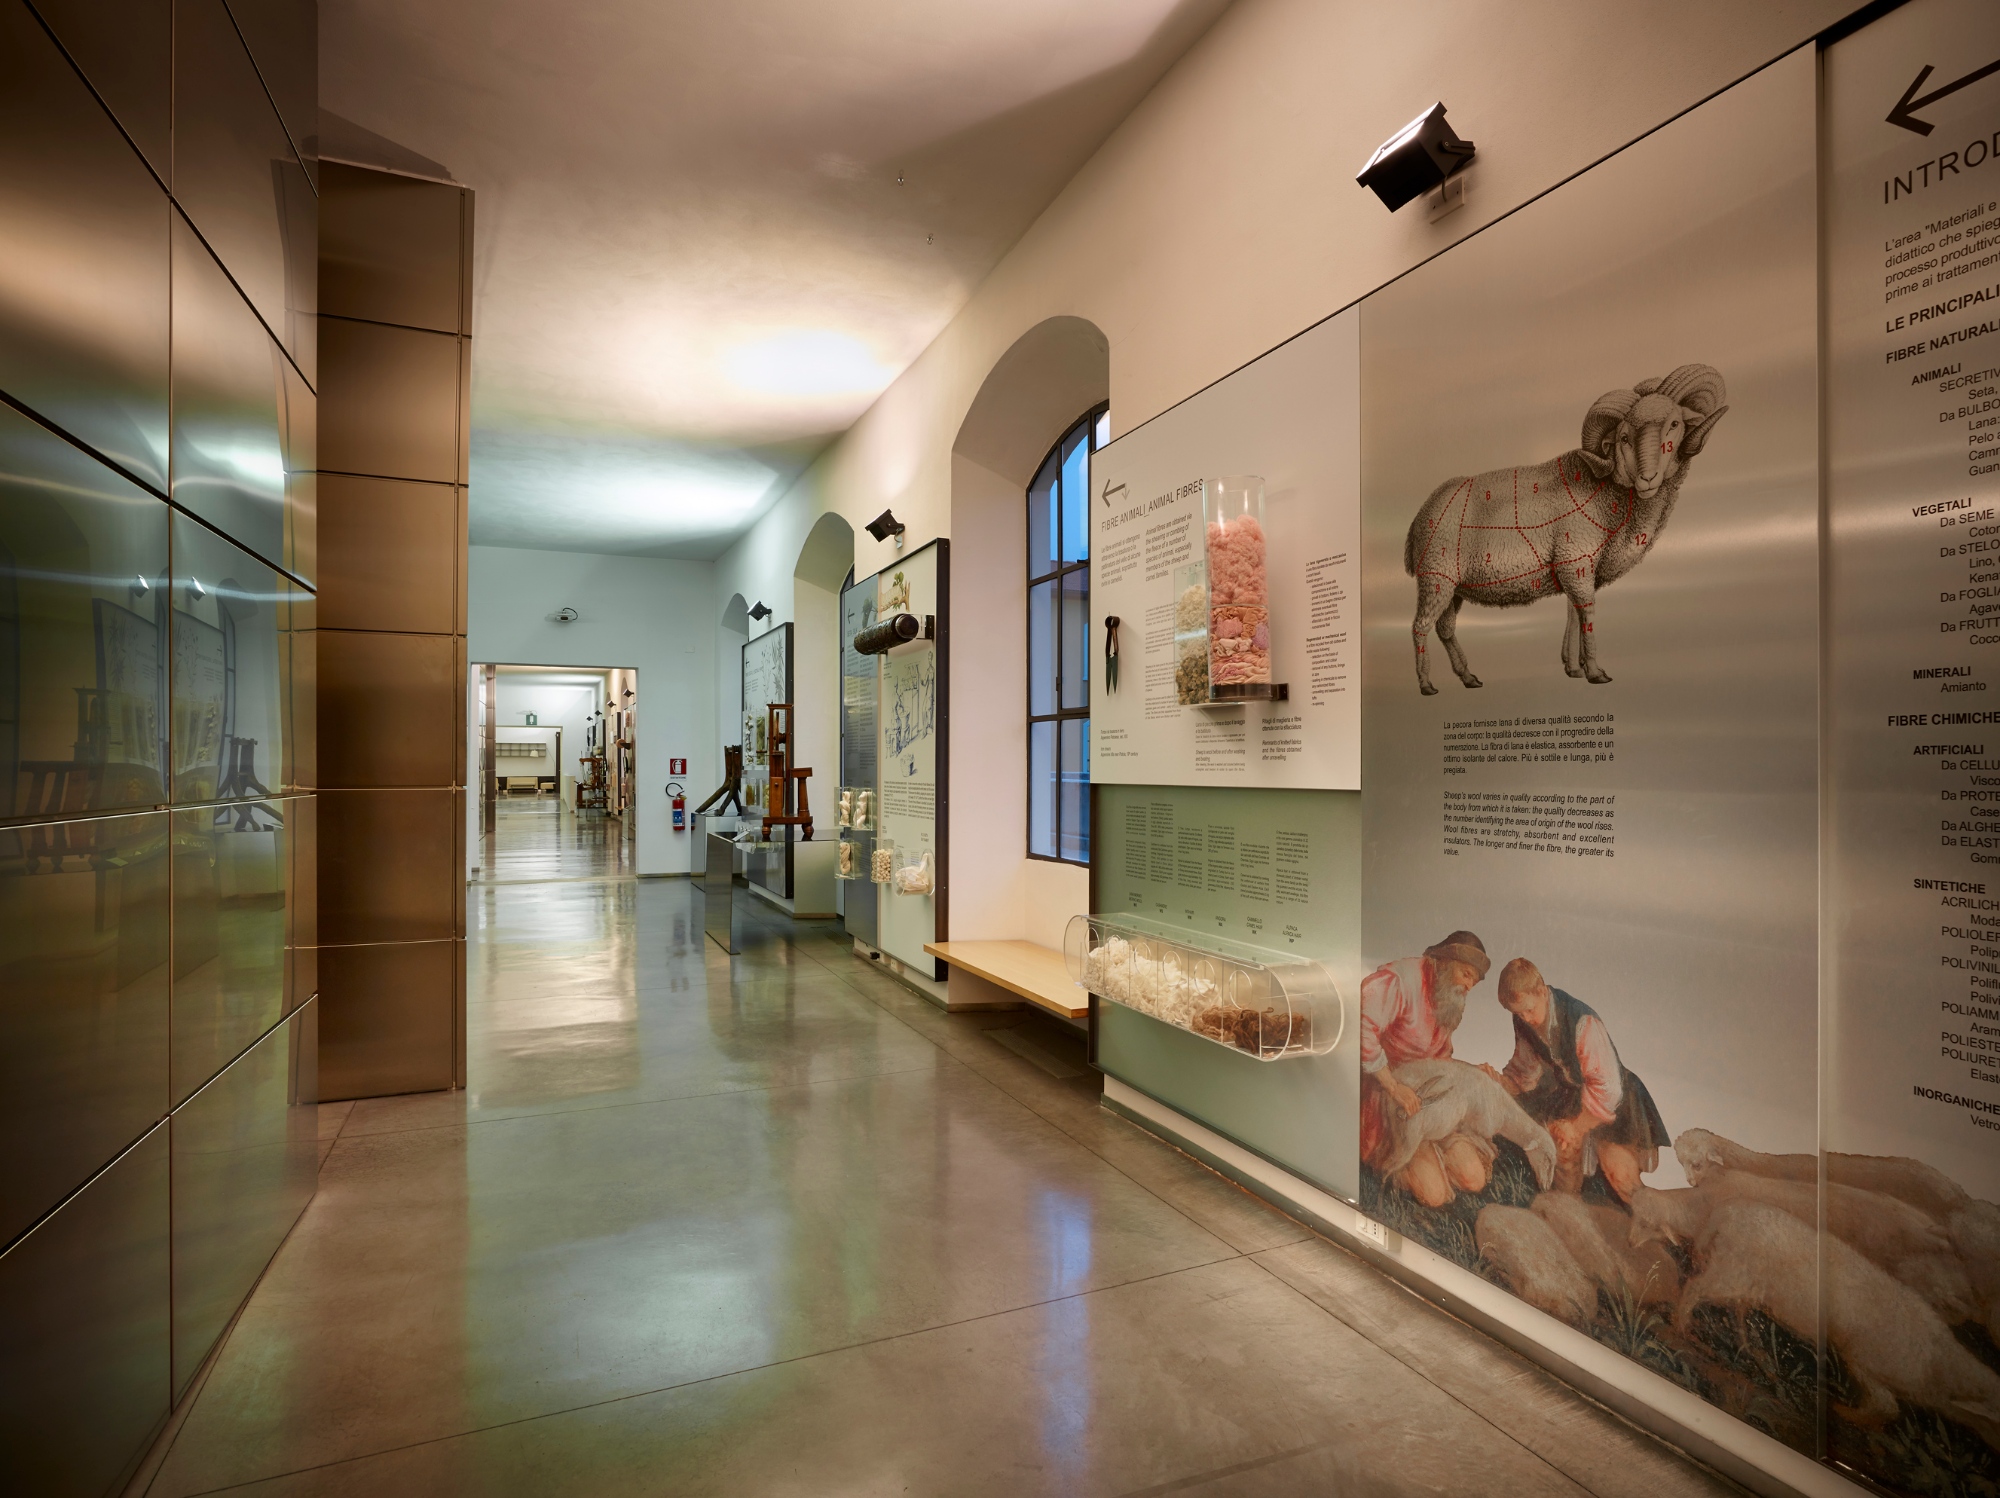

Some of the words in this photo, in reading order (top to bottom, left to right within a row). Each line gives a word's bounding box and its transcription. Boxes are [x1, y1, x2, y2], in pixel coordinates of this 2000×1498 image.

[1925, 203, 1984, 234] "Materiali
[1989, 201, 1996, 211] e
[1885, 242, 1935, 268] didattico
[1939, 233, 1962, 248] che
[1886, 258, 1938, 287] processo
[1886, 283, 1918, 303] prime
[1922, 275, 1933, 288] ai
[1887, 316, 1904, 333] LE
[1910, 284, 2000, 326] PRINCIPALI
[1887, 342, 1925, 364] FIBRE
[1912, 363, 1961, 386] ANIMALI
[1969, 386, 1998, 399] Seta,
[1940, 412, 1955, 423] Da
[1969, 433, 1994, 446] Pelo
[1661, 441, 1672, 453] 13
[1575, 472, 1580, 481] 4
[1534, 484, 1538, 493] 5
[1486, 491, 1490, 500] 6
[1102, 516, 1118, 532] FIBRE
[1176, 478, 1203, 501] FIBRES
[1612, 502, 1618, 513] 3
[1912, 498, 1971, 517] VEGETALI
[1940, 517, 1955, 528] Da
[1959, 509, 1994, 524] SEME
[1565, 532, 1569, 541] 1
[1636, 534, 1646, 544] 12
[1442, 548, 1446, 556] 7
[1940, 547, 1956, 558] Da
[1959, 539, 2000, 555] STELO
[1486, 553, 1490, 563] 2
[1970, 558, 1995, 568] Lino,
[1576, 568, 1585, 578] 11
[1436, 584, 1440, 592] 9
[1531, 579, 1540, 588] 10
[1941, 592, 1956, 603] Da
[1583, 623, 1592, 633] 14
[1941, 622, 1956, 632] Da
[1913, 666, 1971, 680] MINERALI
[1941, 681, 1986, 693] Amianto
[1444, 721, 1450, 729] La
[1515, 718, 1520, 726] di
[1522, 717, 1546, 725] diversa
[1548, 715, 1571, 726] qualità
[1574, 713, 1605, 723] secondo
[1607, 713, 1614, 721] la
[1888, 714, 1927, 727] FIBRE
[1932, 711, 2000, 725] CHIMICHE
[1458, 732, 1466, 740] del
[1486, 731, 1491, 739] la
[1492, 730, 1511, 740] qualità
[1513, 730, 1540, 738] decresce
[1556, 728, 1559, 736] il
[1561, 727, 1595, 738] progredire
[1597, 726, 1614, 735] della
[1481, 743, 1489, 751] La
[1504, 742, 1509, 750] di
[1531, 741, 1557, 750] elastica,
[1559, 740, 1596, 748] assorbente
[1913, 745, 1984, 755] ARTIFICIALI
[1487, 754, 1496, 762] del
[1498, 754, 1519, 762] calore.
[1522, 754, 1532, 762] Più
[1534, 753, 1538, 761] è
[1541, 753, 1561, 761] sottile
[1570, 753, 1592, 763] lunga,
[1595, 752, 1606, 763] più
[1609, 752, 1614, 761] è
[1444, 766, 1467, 775] pregiata.
[1942, 760, 1957, 770] Da
[1970, 775, 2000, 786] Visco
[1468, 792, 1481, 800] wool
[1510, 793, 1531, 803] quality
[1533, 794, 1565, 805] according
[1567, 795, 1574, 803] to
[1577, 795, 1588, 803] the
[1590, 796, 1605, 805] part
[1607, 796, 1615, 804] of
[1942, 790, 1957, 800] Da
[1970, 806, 2000, 817] Case
[1942, 820, 1957, 831] Da
[1444, 825, 1458, 833] Wool
[1524, 830, 1559, 840] absorbent
[1562, 833, 1577, 841] and
[1580, 834, 1614, 844] excellent
[1942, 836, 1957, 846] Da
[1914, 878, 1986, 894] SINTETICHE
[1914, 1085, 2000, 1115] INORGANICHE
[1970, 1114, 2000, 1131] Vetro
